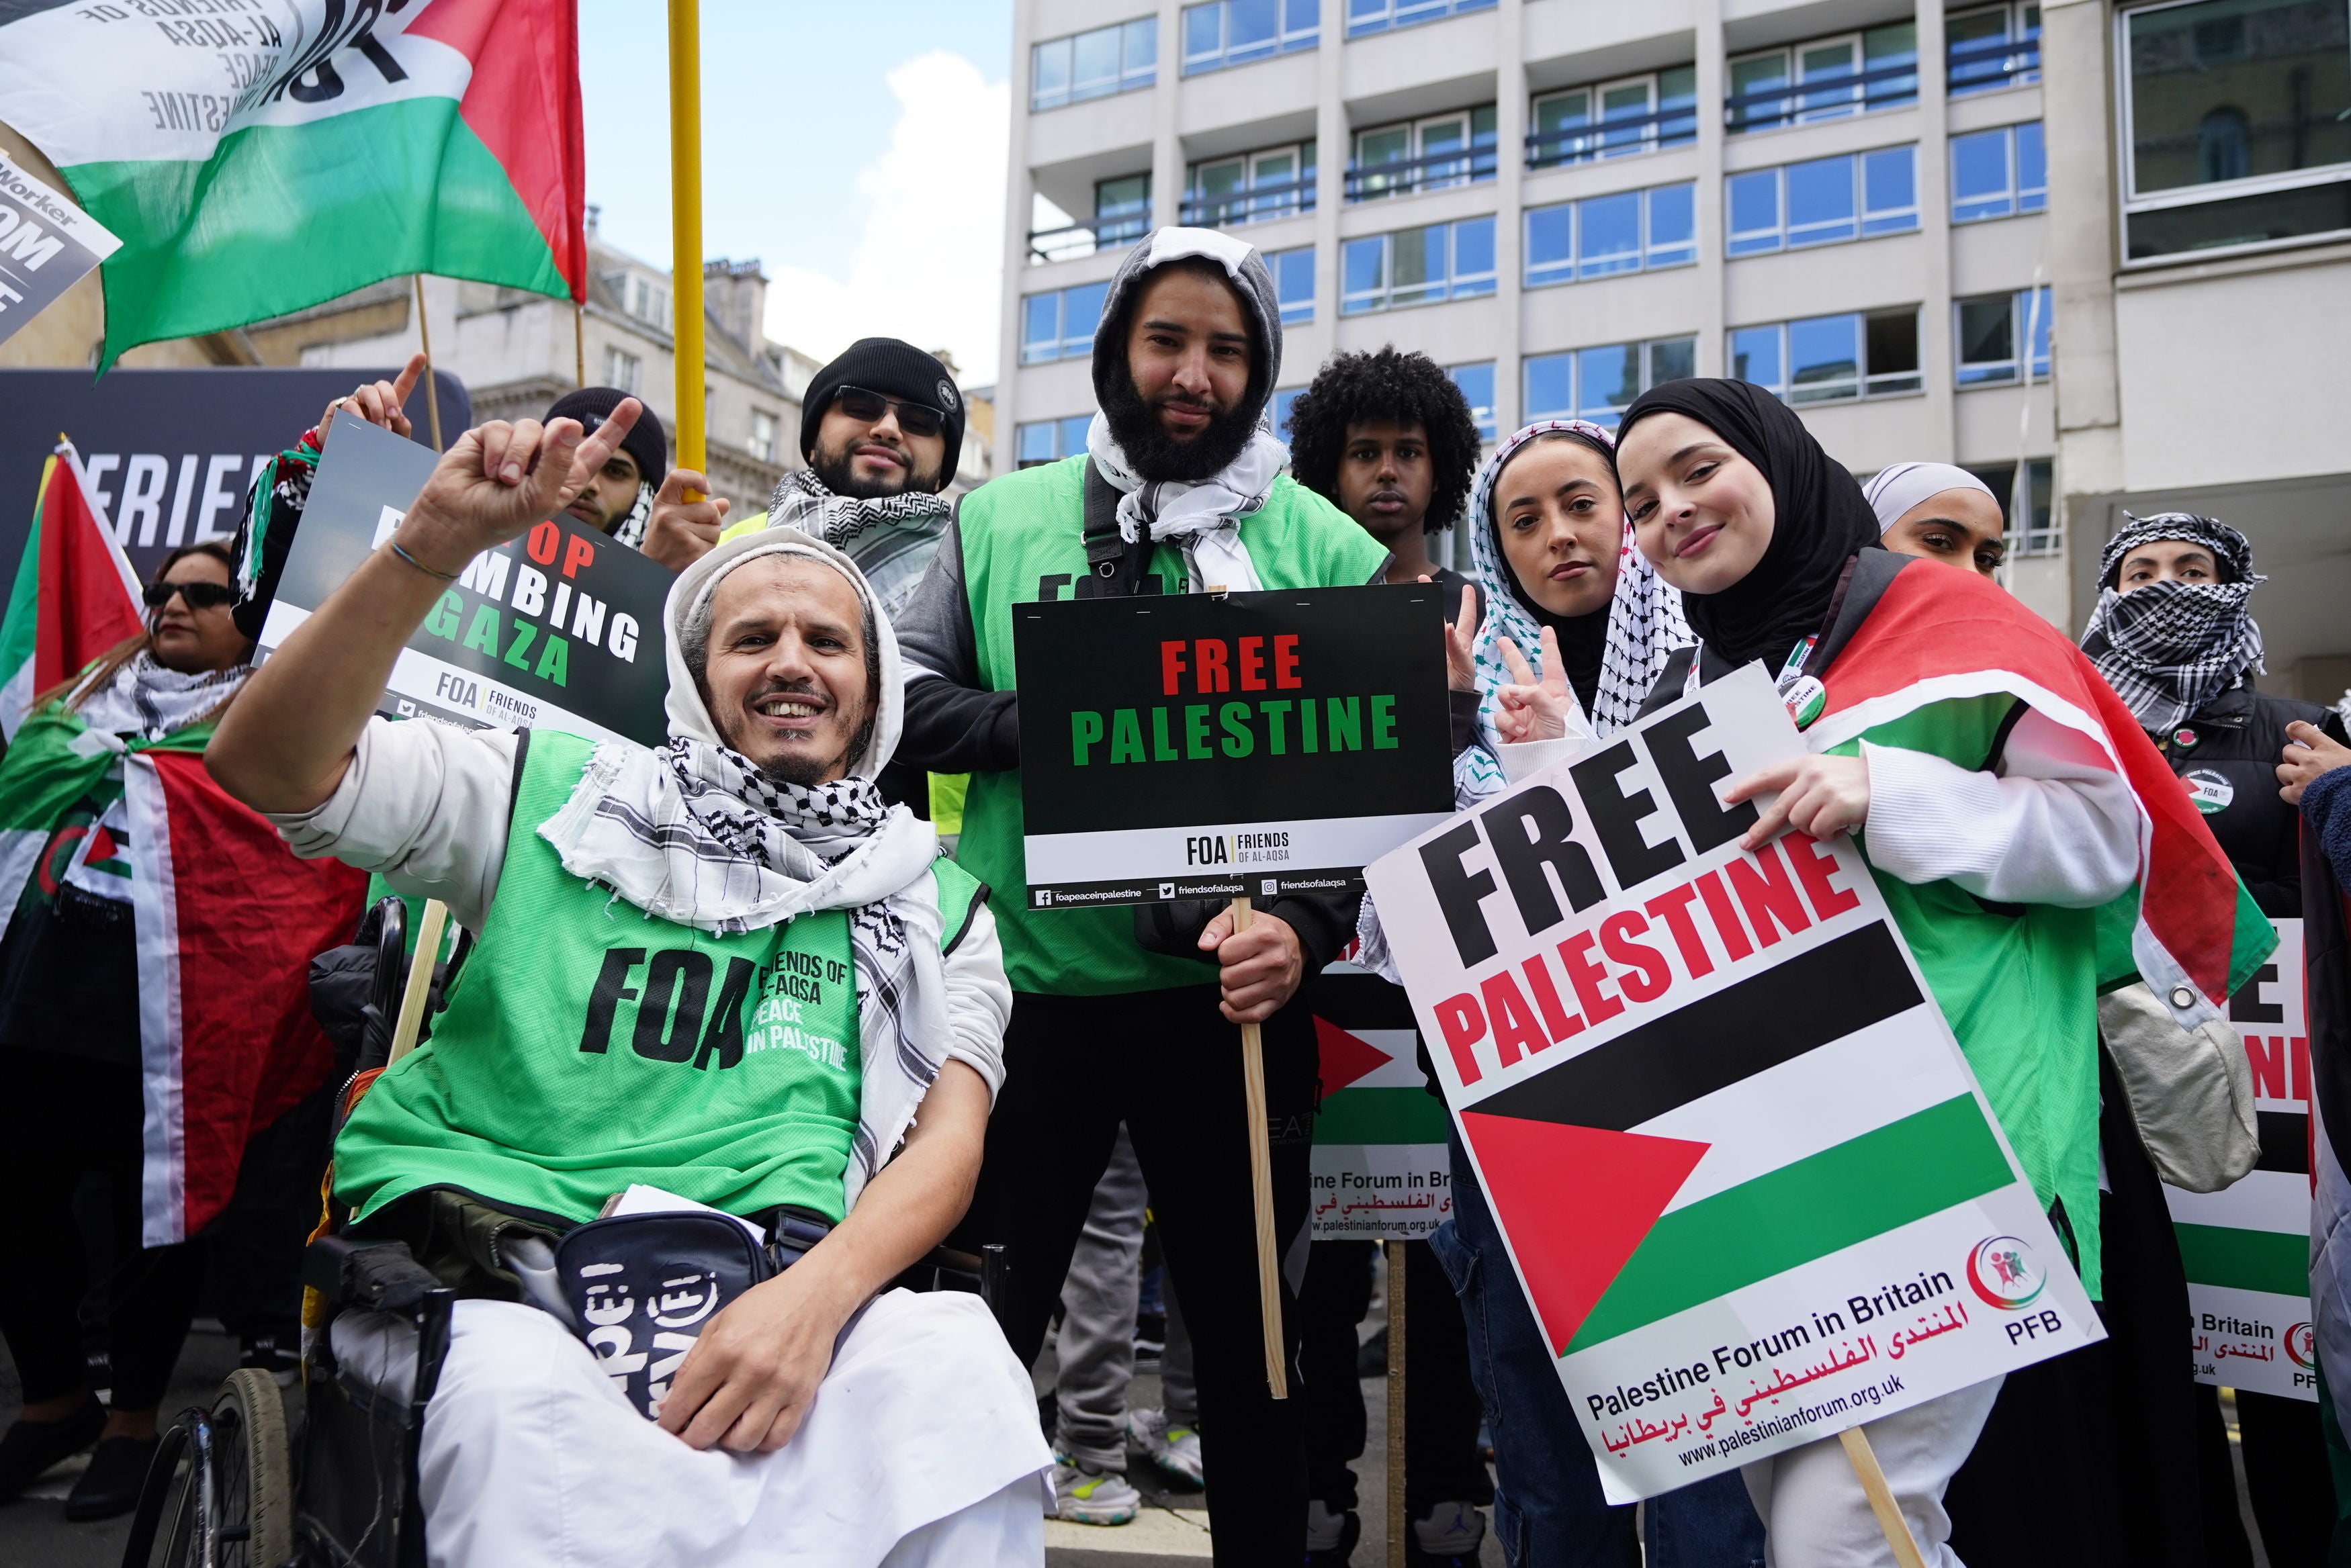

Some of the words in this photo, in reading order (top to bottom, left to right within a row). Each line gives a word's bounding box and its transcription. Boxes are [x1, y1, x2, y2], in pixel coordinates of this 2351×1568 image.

[85, 453, 272, 547] FRIE
[500, 520, 594, 580] OP
[424, 589, 569, 688] GAZA
[1161, 634, 1302, 696] FREE
[436, 672, 478, 709] FOA
[489, 690, 537, 719] FRIENDS
[486, 704, 497, 716] OF
[1071, 694, 1399, 766] PALESTINE
[2201, 769, 2229, 786] PALESTINE
[2203, 787, 2219, 798] FOA
[1187, 835, 1228, 866] FOA
[1237, 832, 1290, 849] FRIENDS
[1418, 701, 1760, 969] FREE
[1239, 851, 1250, 863] OF
[1252, 849, 1290, 862] AL-AQSA
[1055, 888, 1142, 902] foapeaceinpalestine
[1178, 883, 1244, 895] friendsofalaqsa
[1280, 878, 1347, 890] friendsofalaqsa
[826, 960, 848, 986] OF
[1433, 830, 1861, 1088] PALESTINE
[579, 947, 756, 1071] FOA
[746, 1029, 766, 1054] IN
[1341, 1172, 1402, 1189] Forum
[1408, 1172, 1424, 1188] in
[1315, 1192, 1337, 1221] في
[1341, 1192, 1435, 1221] الفلسطيني
[1313, 1218, 1441, 1233] w.palestinianforum.org.uk
[1887, 1301, 1969, 1360] المنتدى
[2005, 1309, 2063, 1346] PFB
[2202, 1313, 2274, 1340] Britain
[1586, 1362, 1710, 1422] Palestine
[1712, 1324, 1811, 1375] Forum
[1812, 1311, 1845, 1338] in
[1847, 1271, 1955, 1325] Britain
[2214, 1342, 2274, 1363] المنتدى
[1734, 1333, 1878, 1426] الفلسطيني
[2293, 1372, 2317, 1389] PF
[1678, 1373, 1905, 1467] www.palestinianforum.org.uk
[1695, 1387, 1726, 1440] في
[1601, 1412, 1693, 1458] بريطانيا
